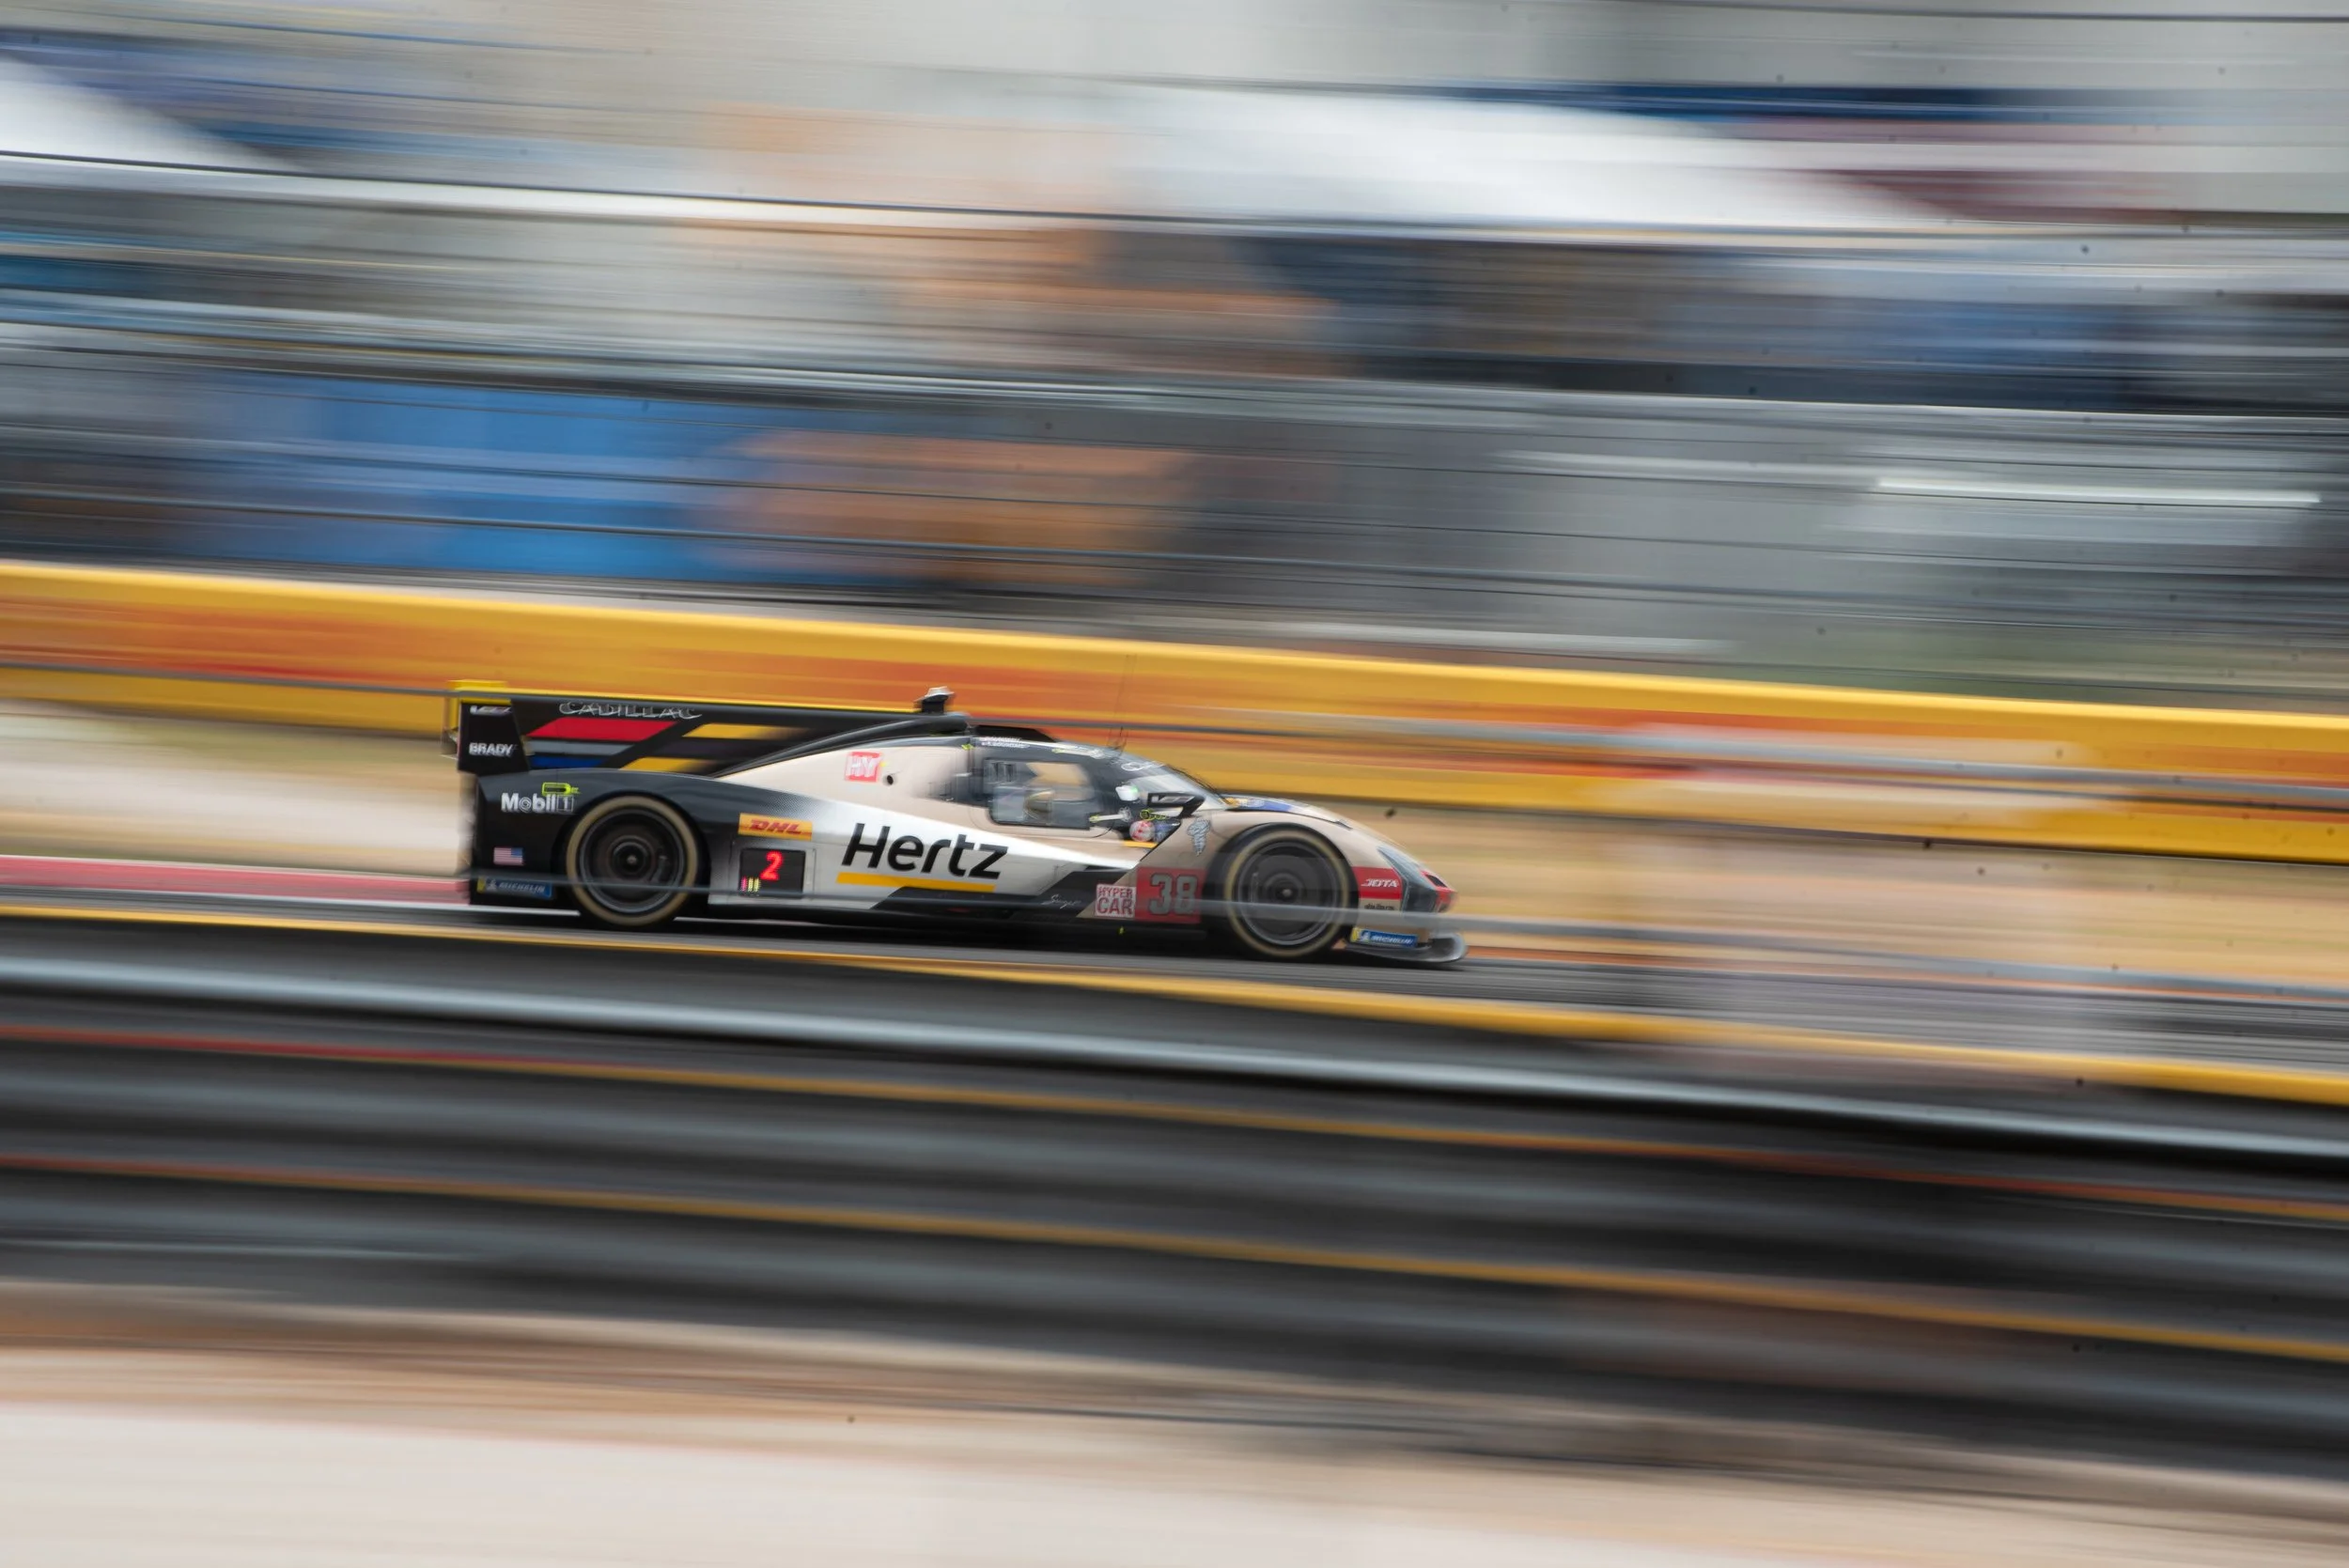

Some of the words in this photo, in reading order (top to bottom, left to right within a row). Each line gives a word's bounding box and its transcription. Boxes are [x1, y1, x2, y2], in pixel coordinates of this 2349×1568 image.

[559, 702, 703, 720] CADILLAC
[469, 742, 512, 756] BRADY
[501, 792, 556, 813] Mobil
[749, 819, 801, 834] DHL
[841, 823, 1008, 879] Hertz
[759, 850, 783, 880] 2
[1361, 878, 1398, 888] JOTA
[1097, 886, 1133, 899] HYPER
[1149, 873, 1197, 916] 38
[1097, 897, 1133, 915] CAR
